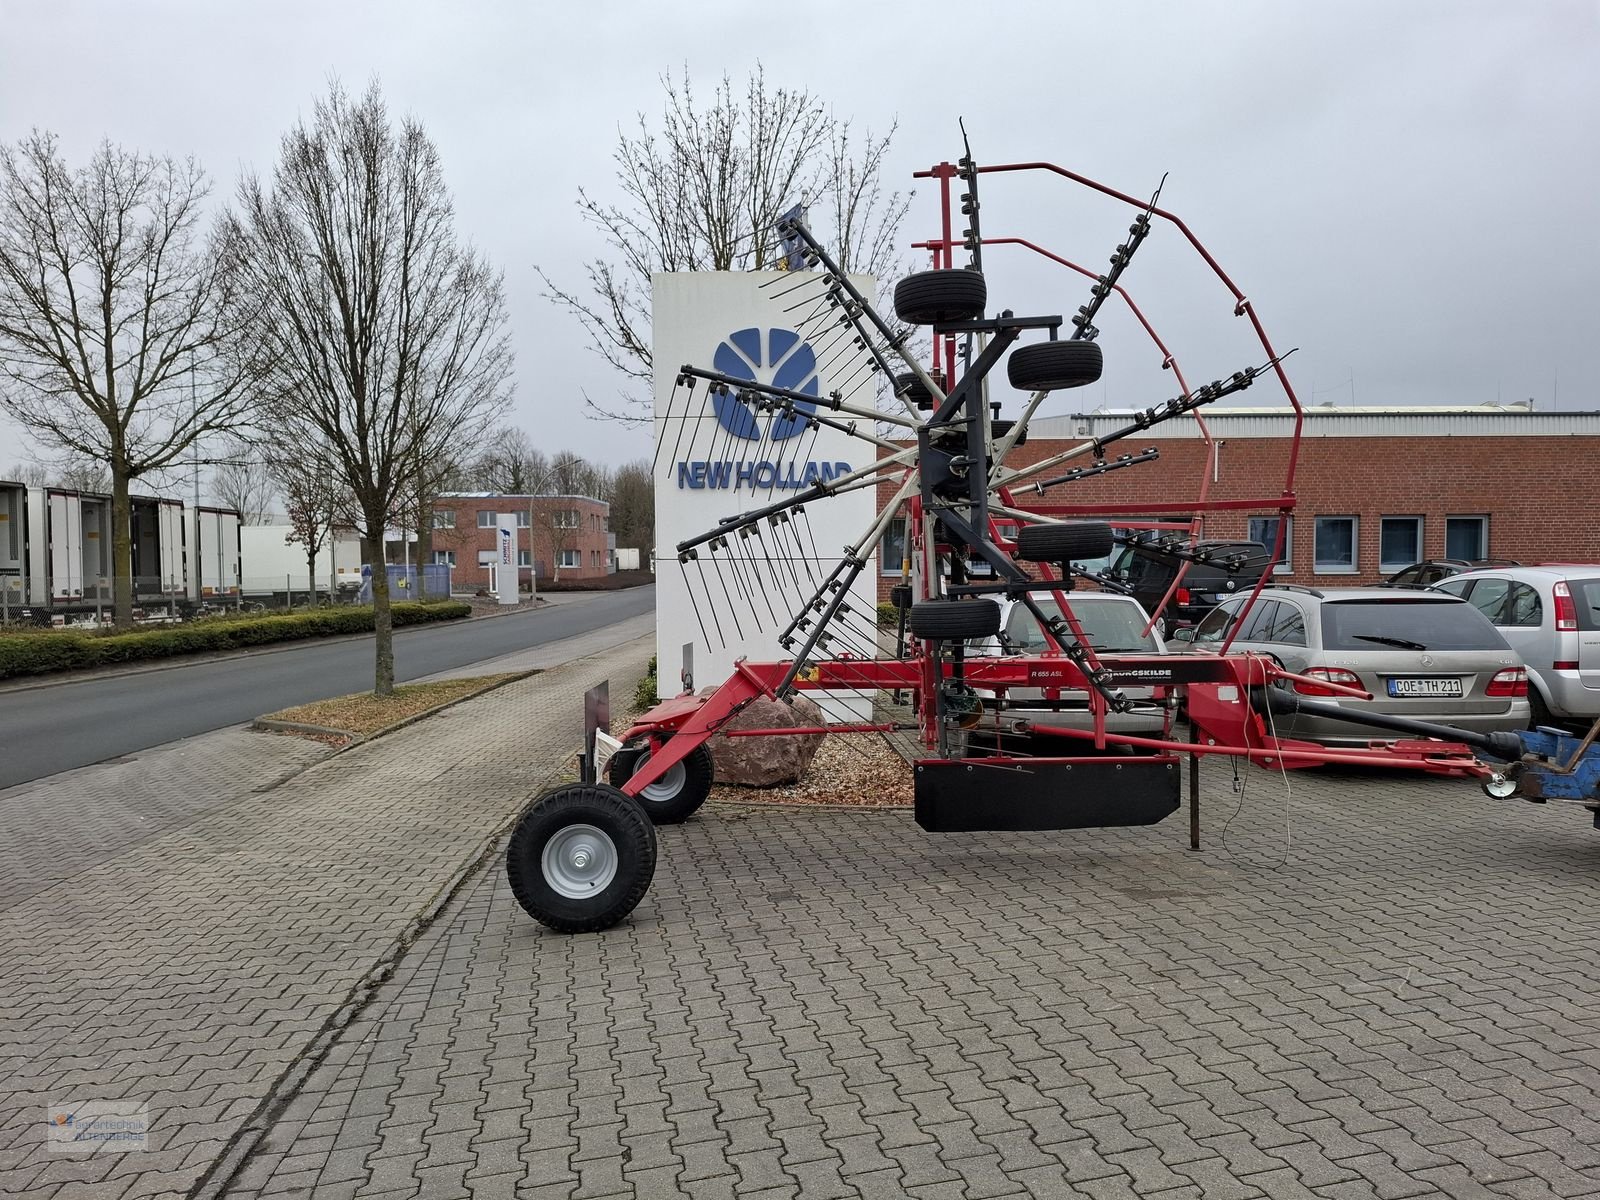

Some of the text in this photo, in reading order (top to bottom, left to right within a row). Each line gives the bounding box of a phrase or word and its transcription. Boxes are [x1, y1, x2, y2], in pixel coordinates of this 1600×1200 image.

[678, 461, 732, 489] NEW
[1396, 680, 1460, 692] COE TH 211
